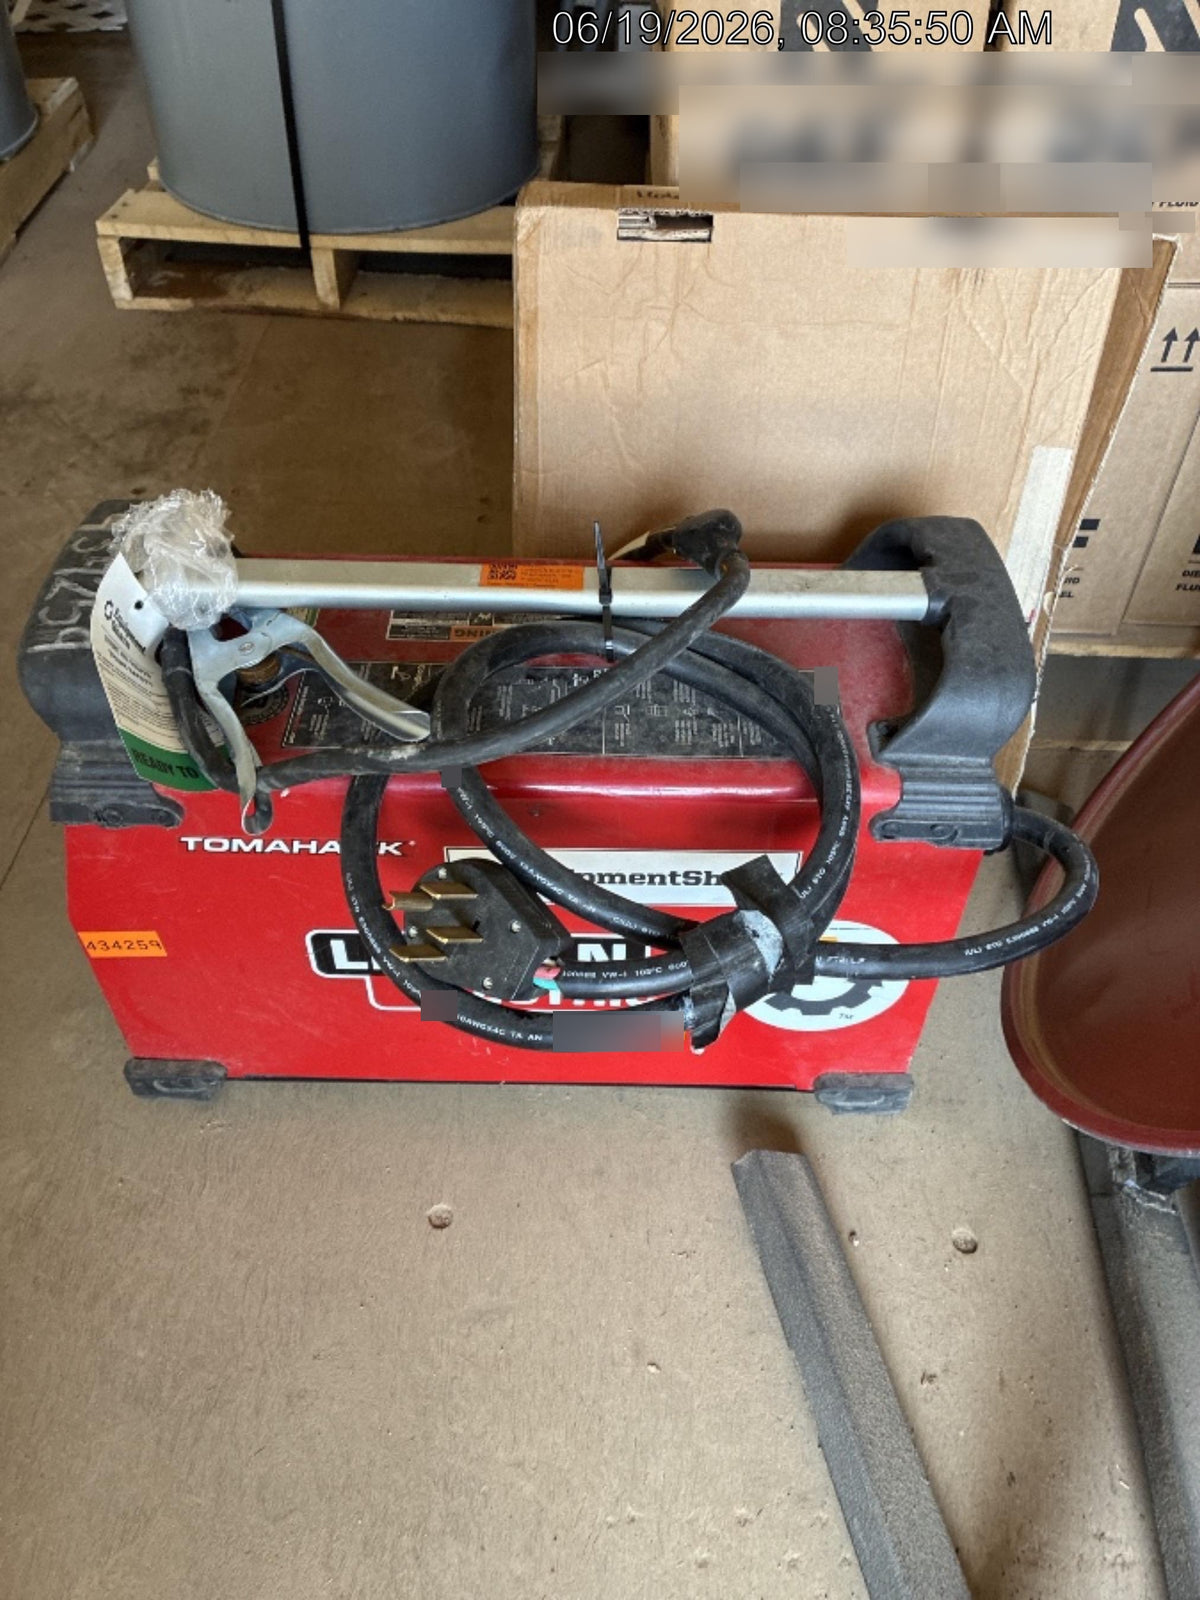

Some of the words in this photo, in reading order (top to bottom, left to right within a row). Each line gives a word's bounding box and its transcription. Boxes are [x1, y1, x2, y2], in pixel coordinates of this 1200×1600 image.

[175, 765, 201, 780] TO
[180, 836, 403, 856] TOMAHAK
[86, 939, 163, 952] 434259
